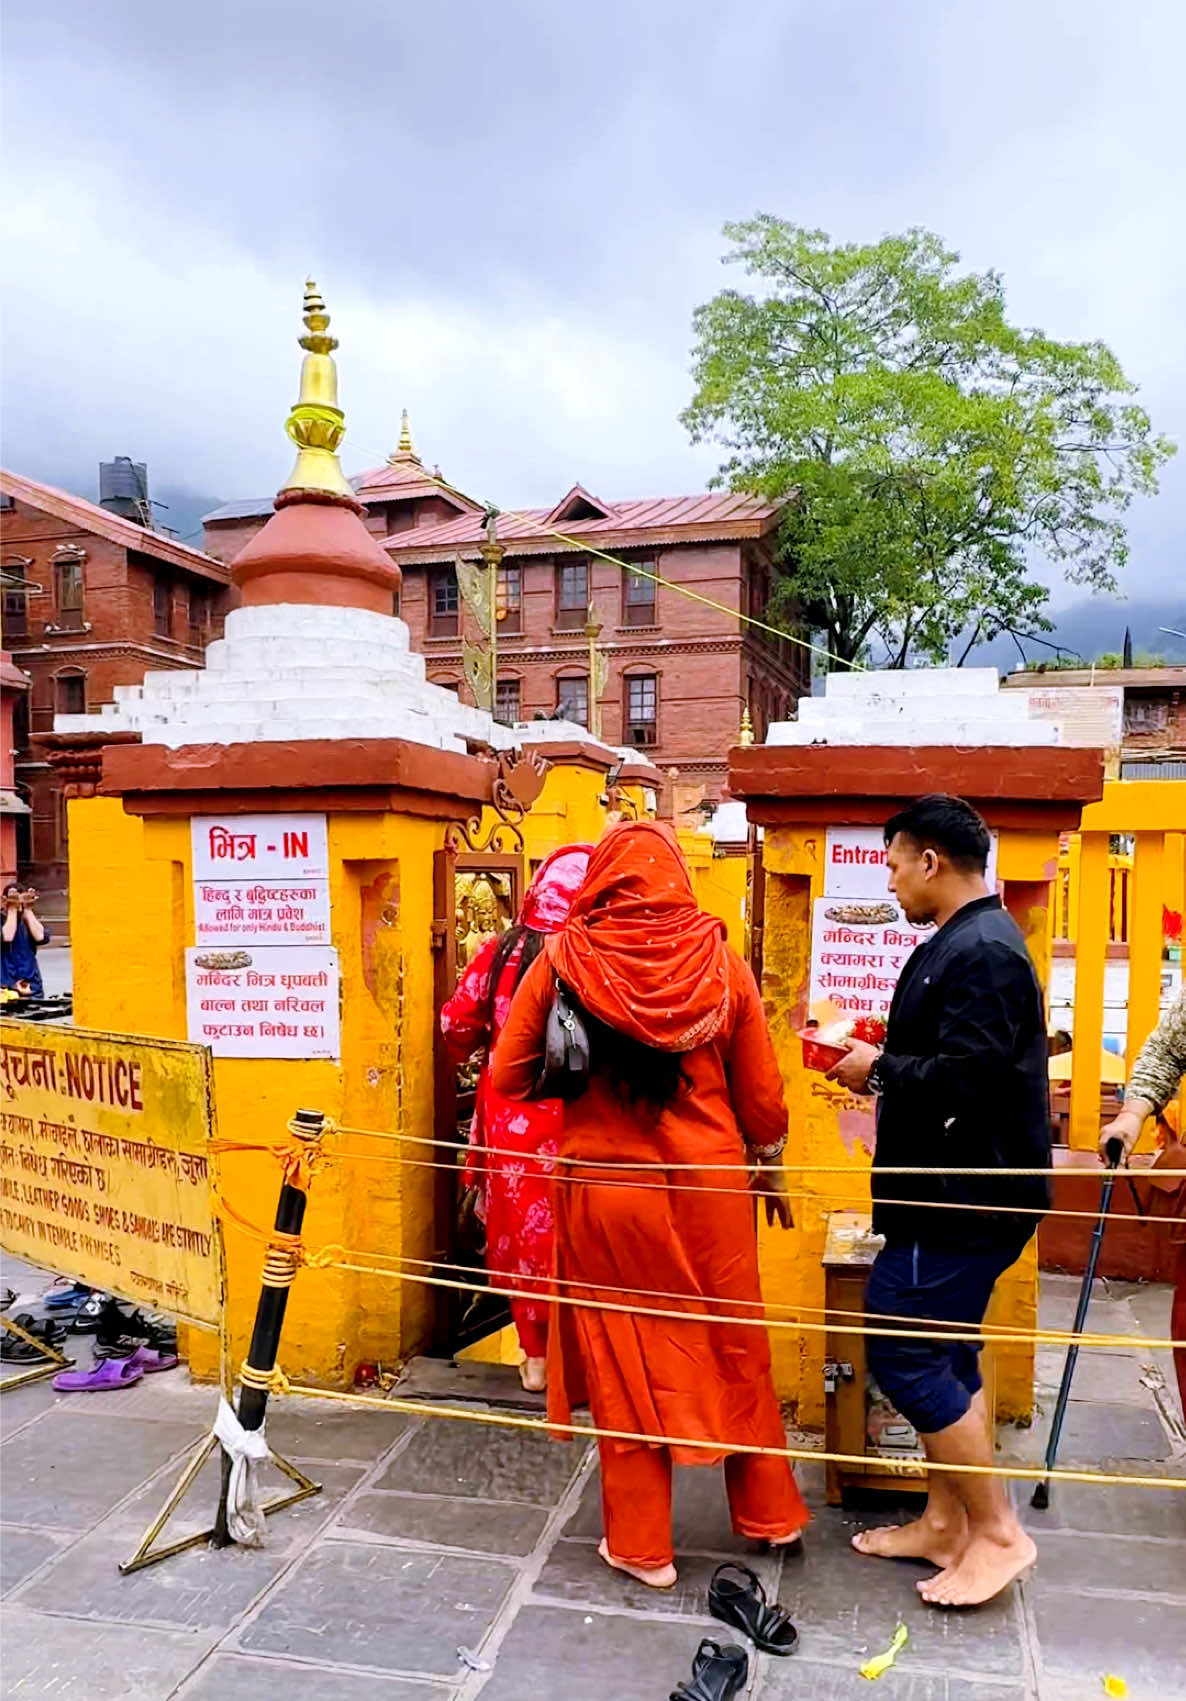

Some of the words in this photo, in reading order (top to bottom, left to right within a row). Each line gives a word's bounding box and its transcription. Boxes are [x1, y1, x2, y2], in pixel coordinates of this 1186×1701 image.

[209, 826, 257, 861] भित्र
[283, 832, 308, 859] IN
[832, 844, 888, 864] Entran
[216, 904, 244, 921] लागि
[247, 908, 273, 921] मात्र
[276, 903, 304, 921] प्रवेश
[823, 927, 878, 945] मन्दिर
[883, 929, 919, 947] भित्र
[820, 953, 885, 968] क्यामरा
[196, 971, 242, 987] मन्दिर
[246, 971, 276, 987] भित्र
[241, 999, 269, 1012] तथा
[259, 1021, 299, 1037] निषेध
[65, 1051, 143, 1110] NOTICE
